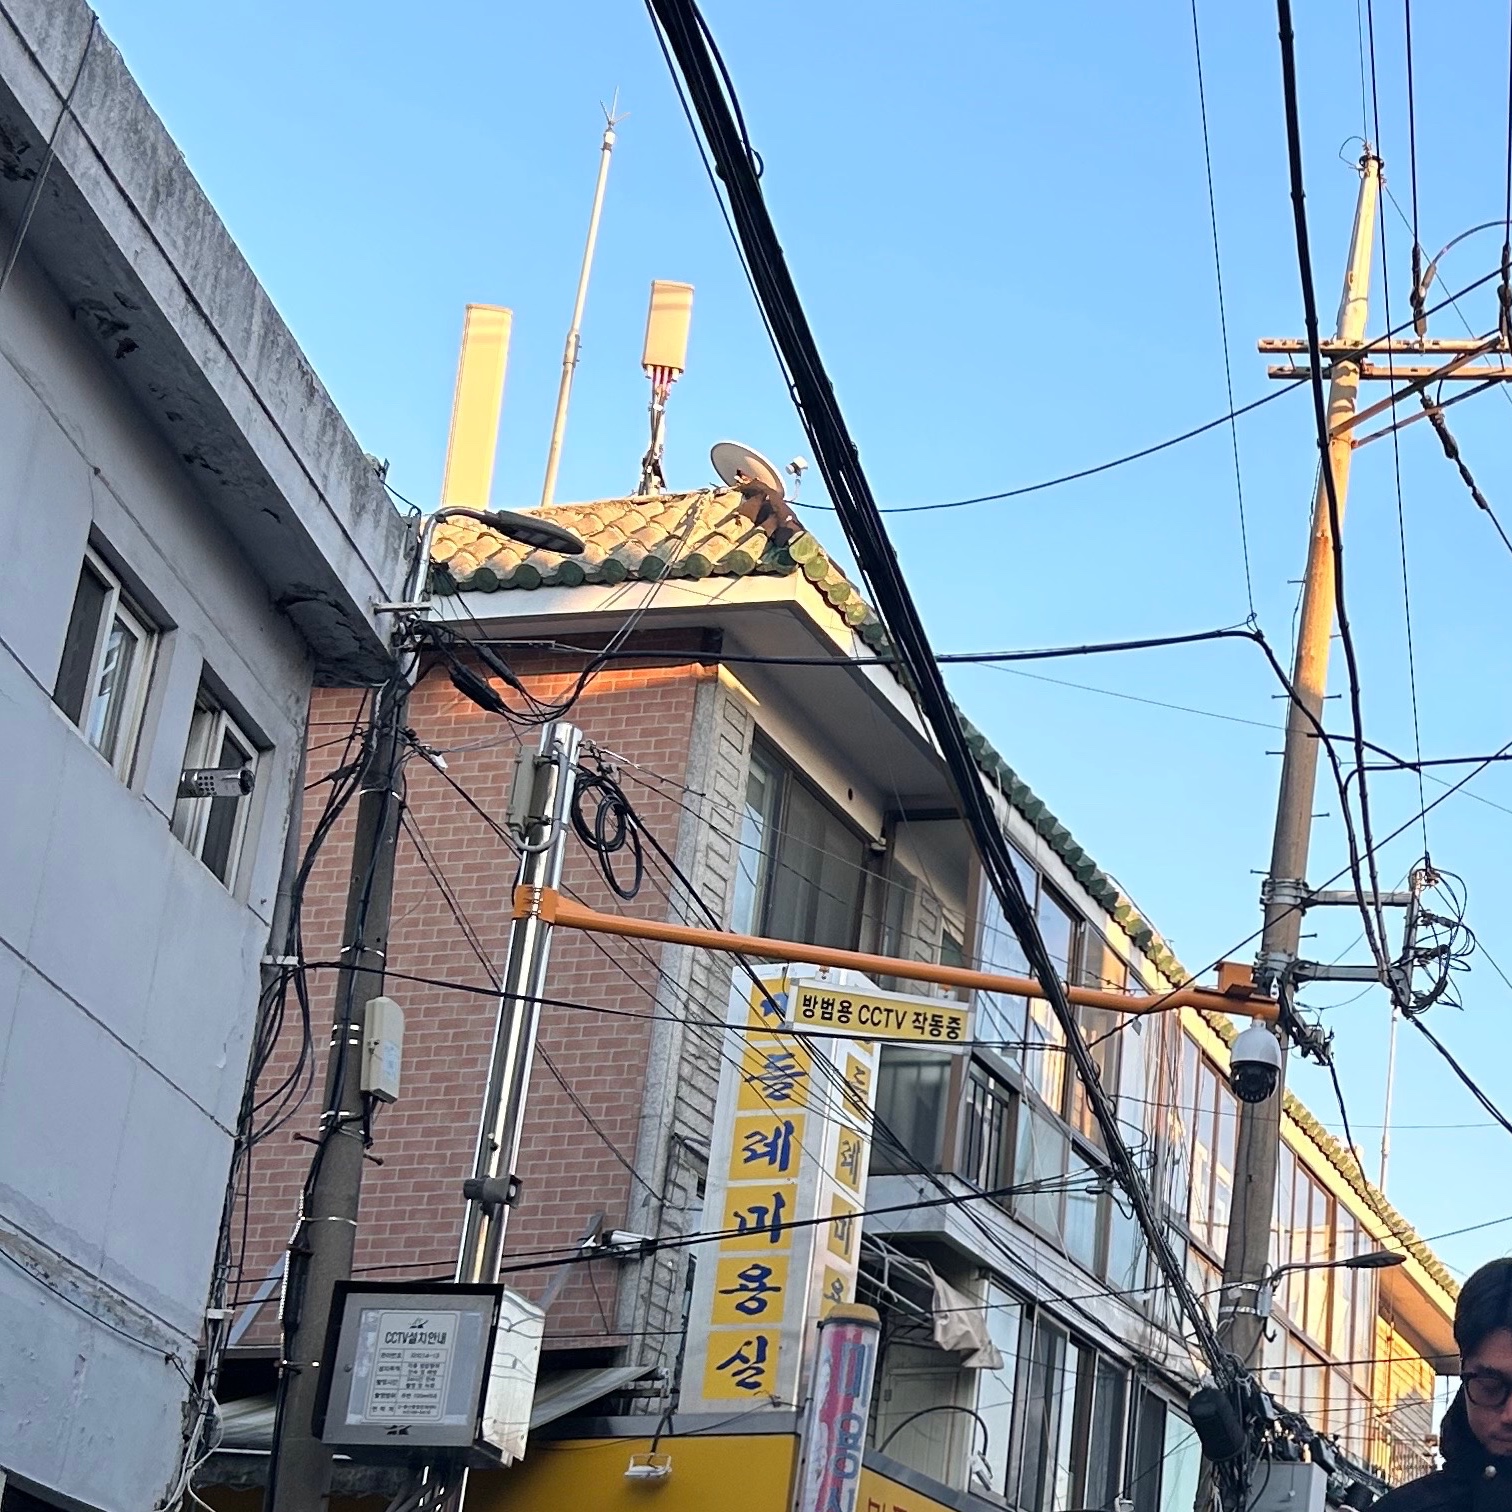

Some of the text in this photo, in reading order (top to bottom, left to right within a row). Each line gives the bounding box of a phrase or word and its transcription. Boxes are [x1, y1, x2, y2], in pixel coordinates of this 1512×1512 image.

[802, 994, 962, 1040] 방범용 CCTV 작동중
[384, 1331, 448, 1345] CCTV설치안내
